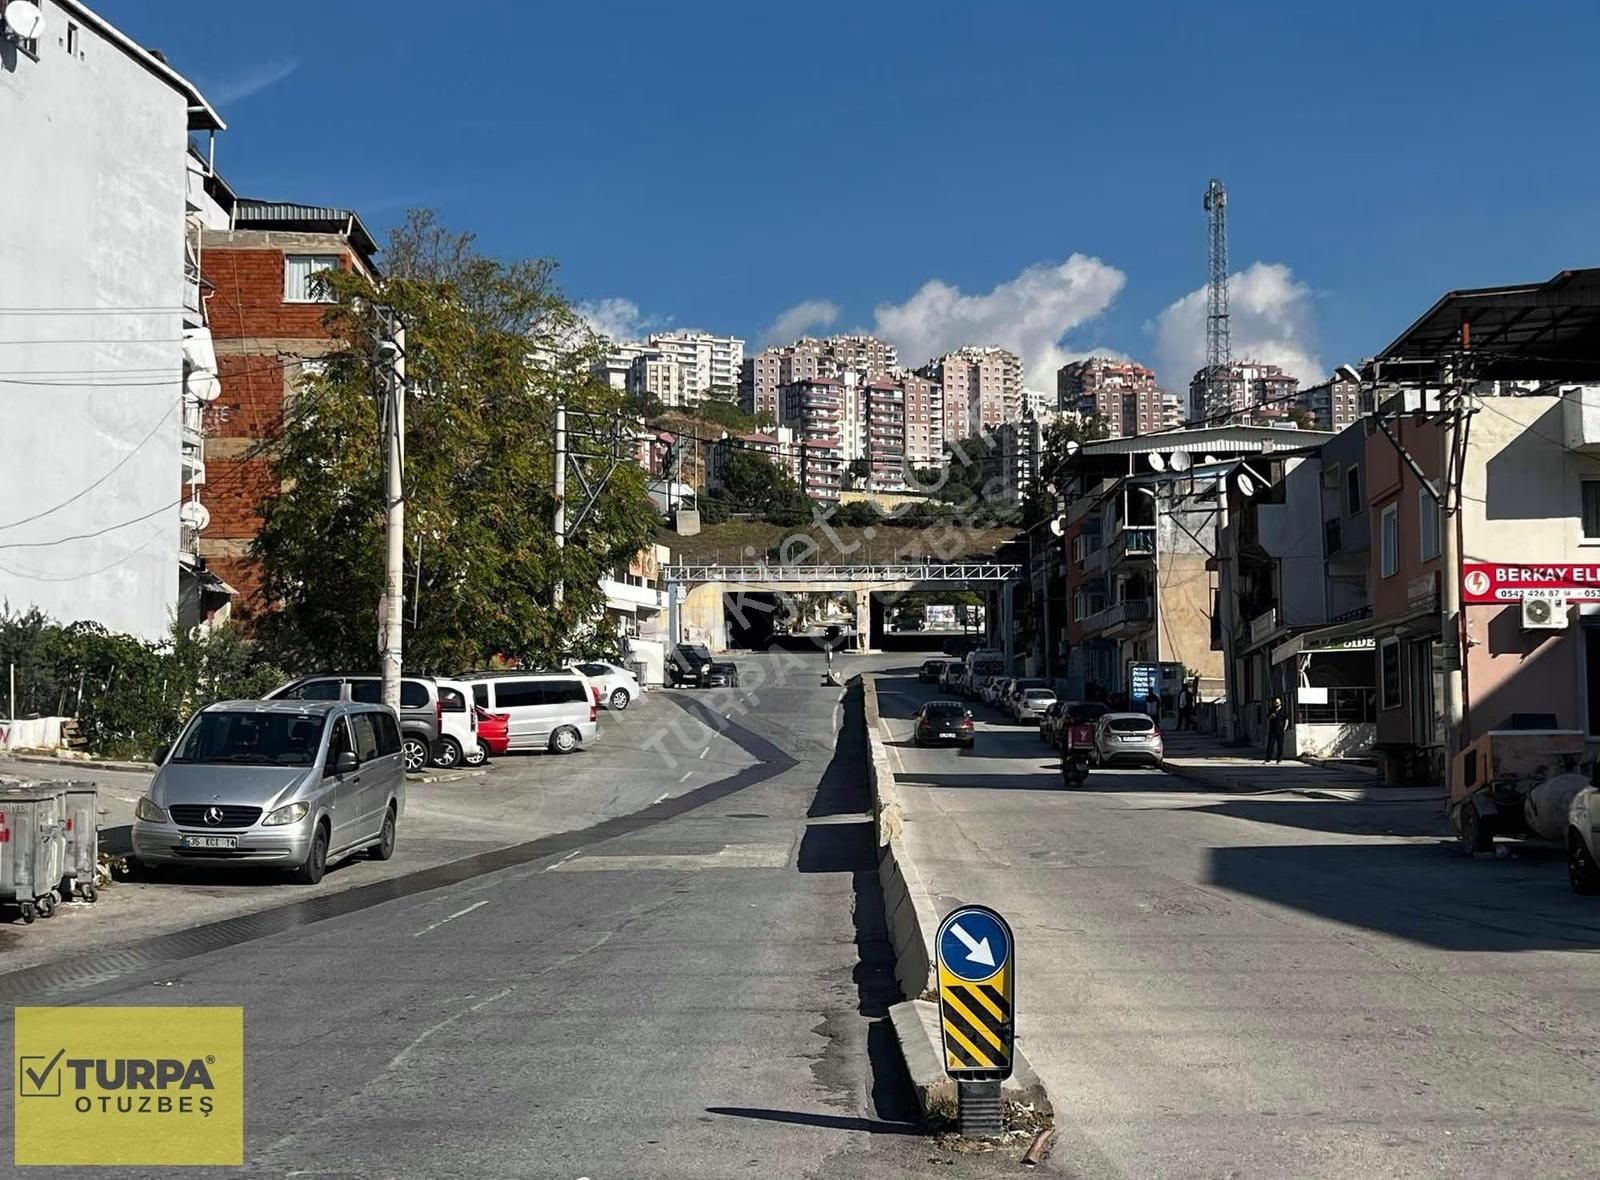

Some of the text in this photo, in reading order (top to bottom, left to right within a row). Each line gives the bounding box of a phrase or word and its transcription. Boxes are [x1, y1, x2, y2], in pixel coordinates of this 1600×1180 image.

[1495, 567, 1568, 582] BERKAY
[1527, 590, 1546, 598] 426
[191, 837, 200, 846] 35
